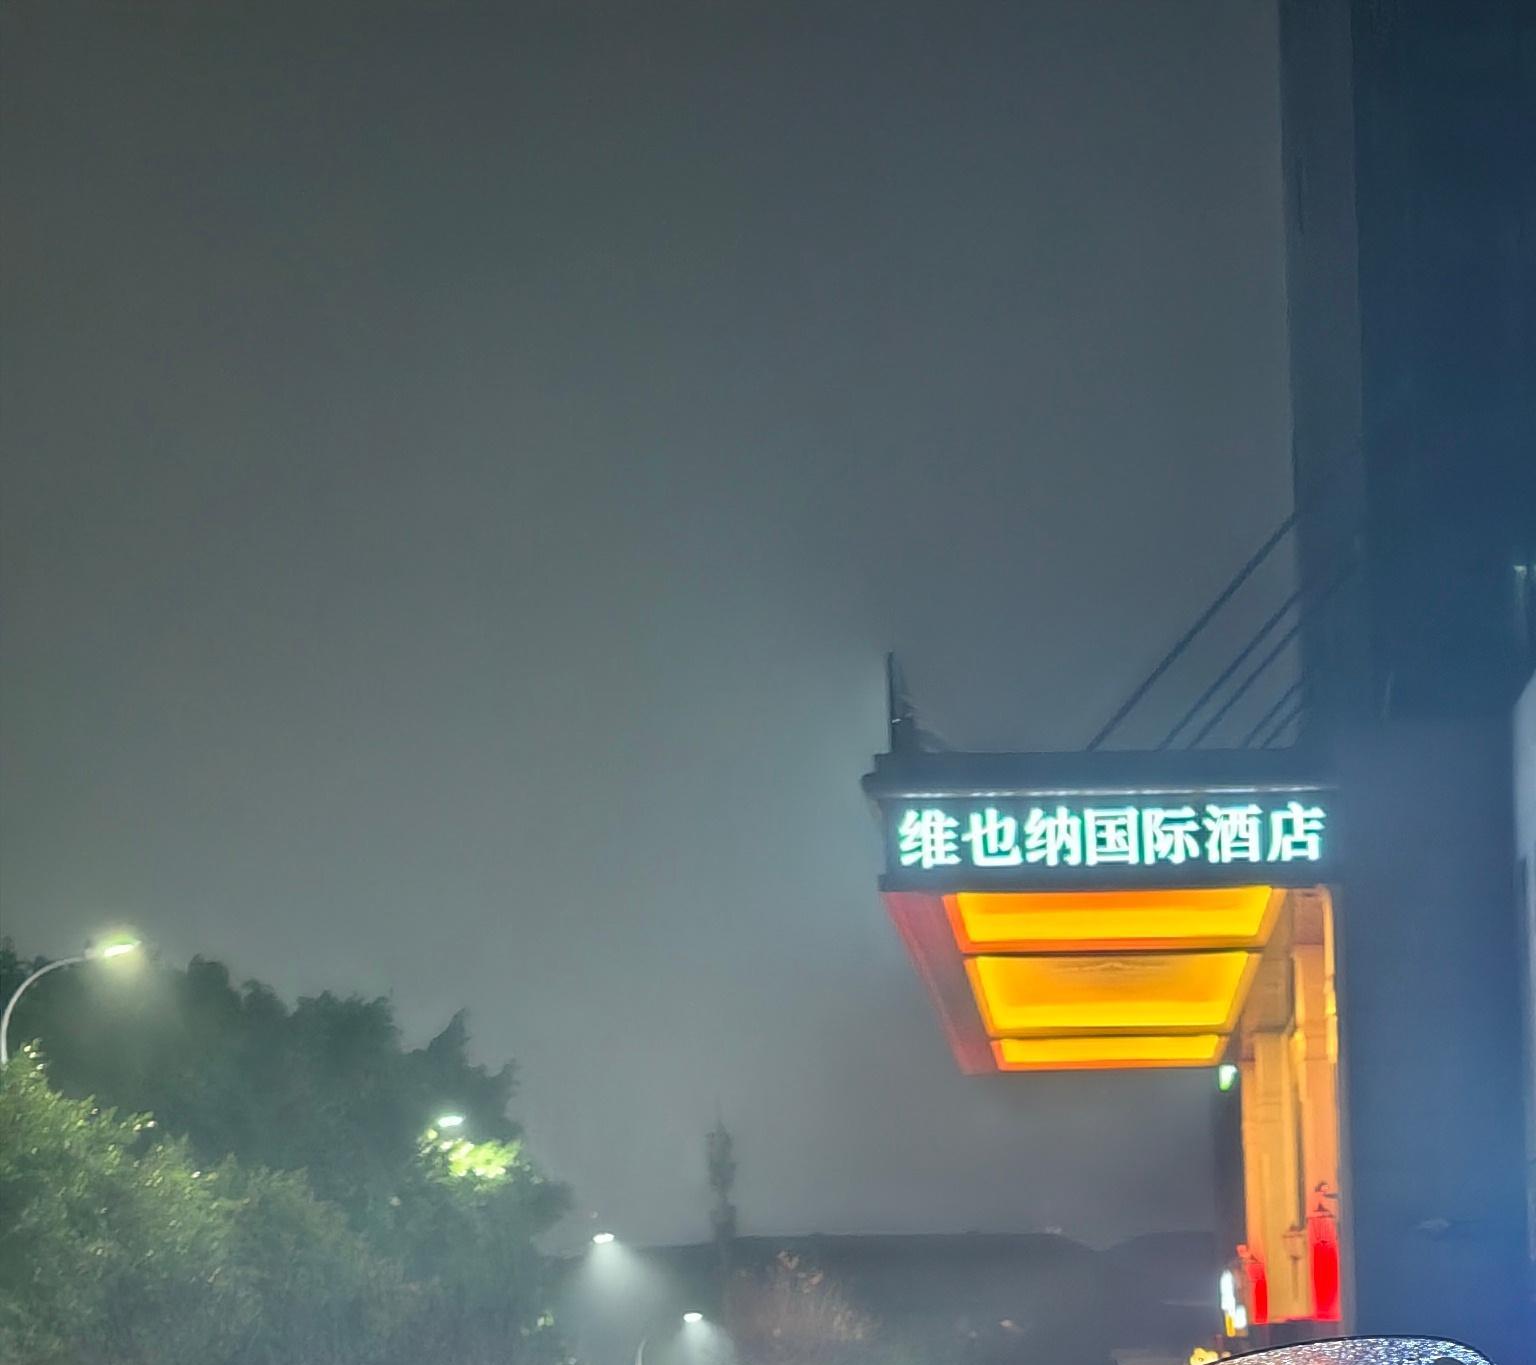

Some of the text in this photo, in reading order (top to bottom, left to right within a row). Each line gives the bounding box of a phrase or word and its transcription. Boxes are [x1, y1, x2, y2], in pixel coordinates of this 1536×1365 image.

[898, 802, 1327, 868] 维也纳国际酒店
